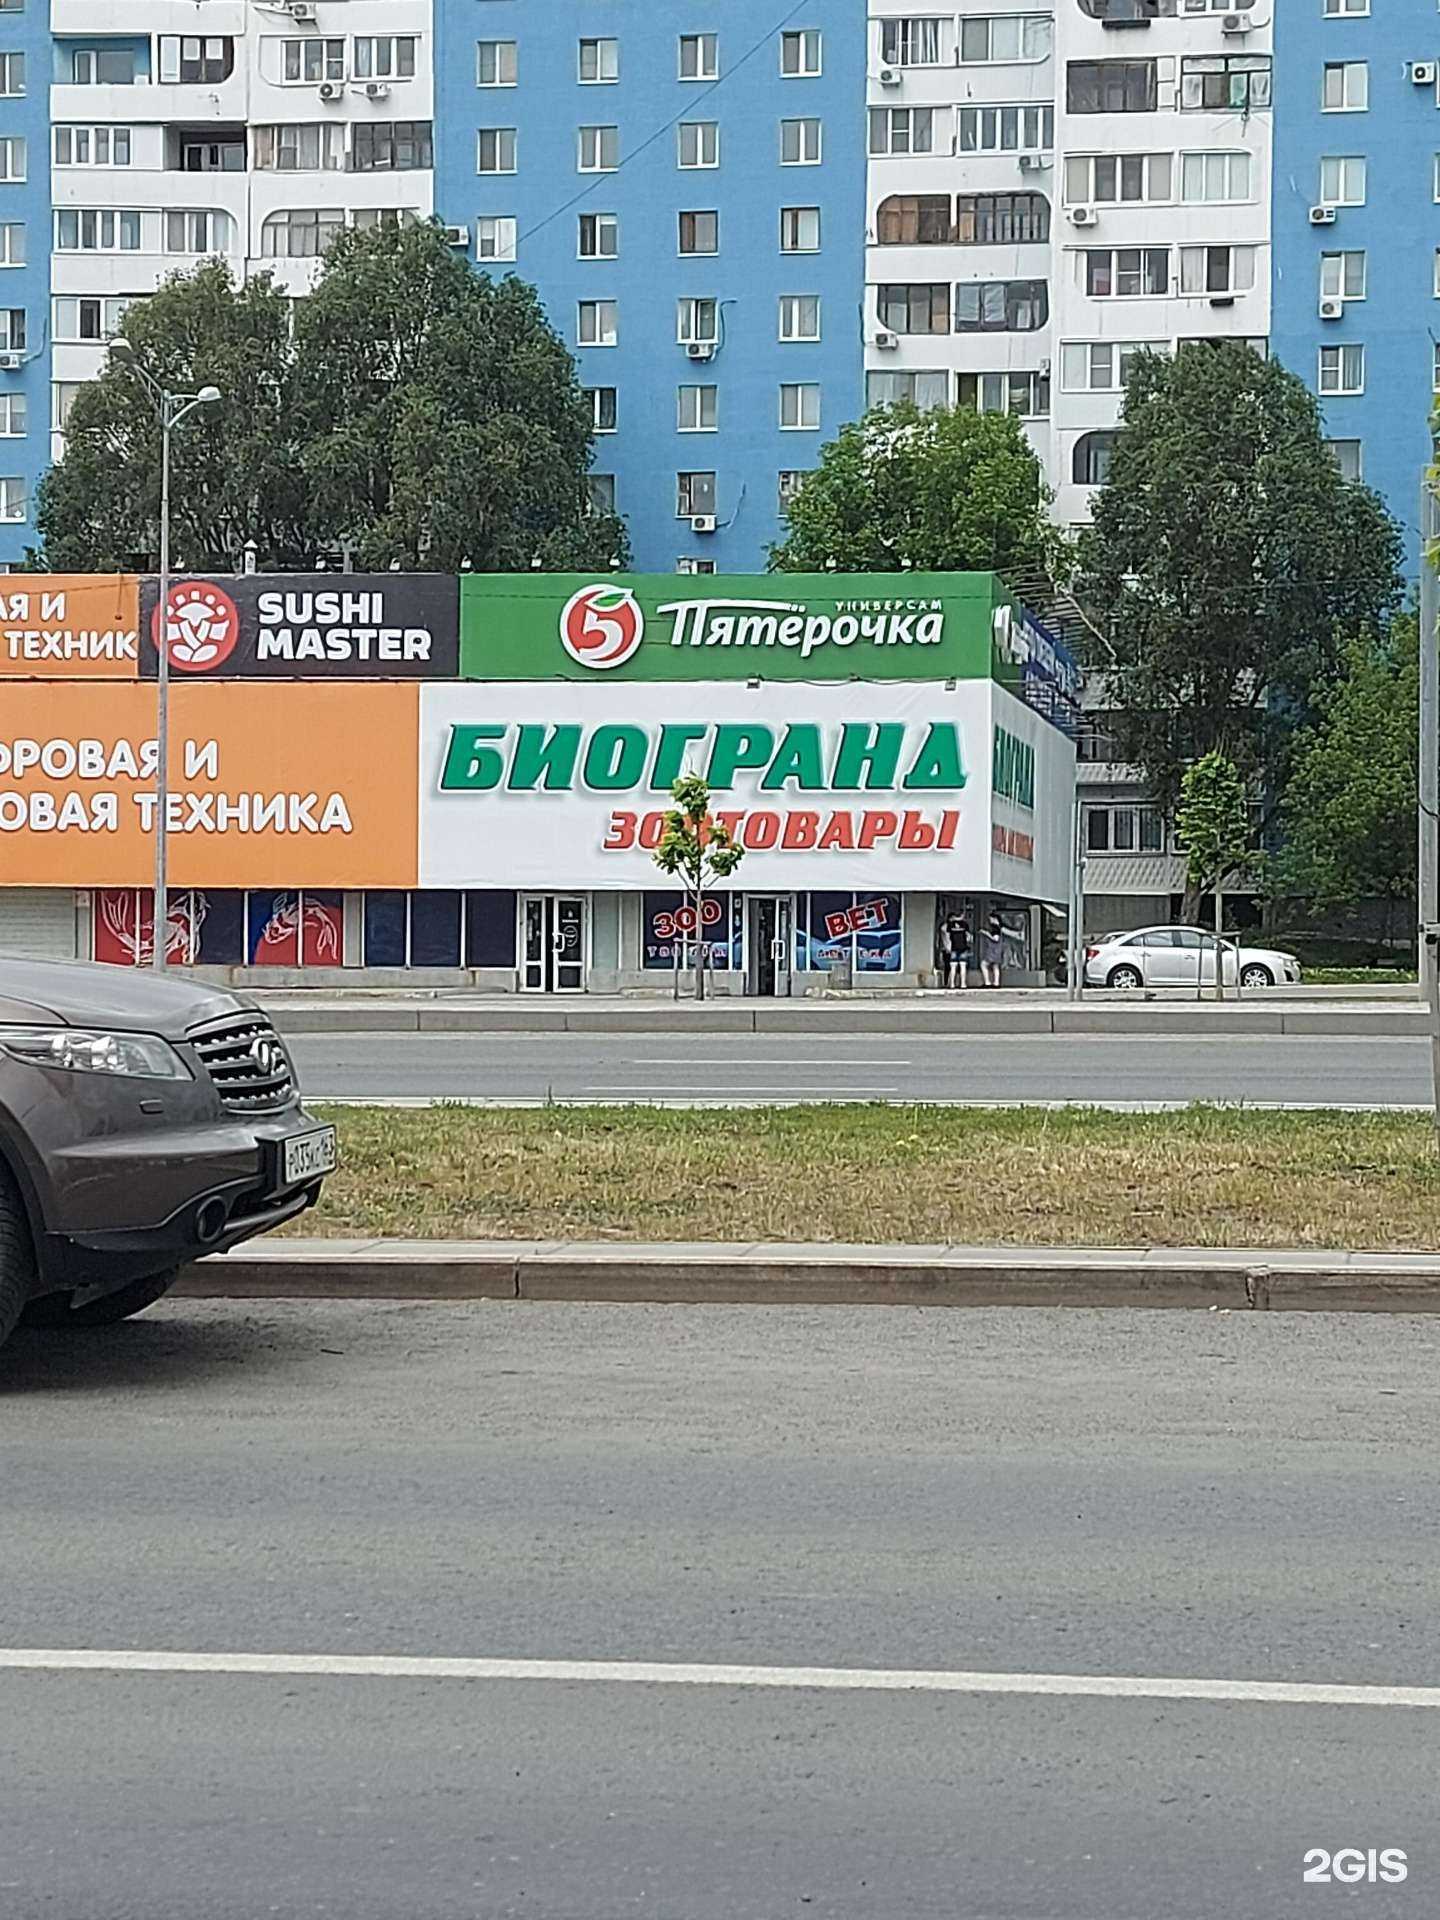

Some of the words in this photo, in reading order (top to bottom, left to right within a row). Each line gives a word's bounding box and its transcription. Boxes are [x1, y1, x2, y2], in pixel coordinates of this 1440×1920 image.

[41, 592, 65, 621] И
[258, 592, 383, 624] SUSHI
[835, 600, 942, 611] УНИВЕРСАМ
[4, 630, 138, 659] ТЕХНИК
[257, 628, 431, 660] MASTER
[184, 740, 218, 779] И
[440, 723, 969, 791] БИОГРАНД
[133, 792, 353, 833] ТЕХНИКА
